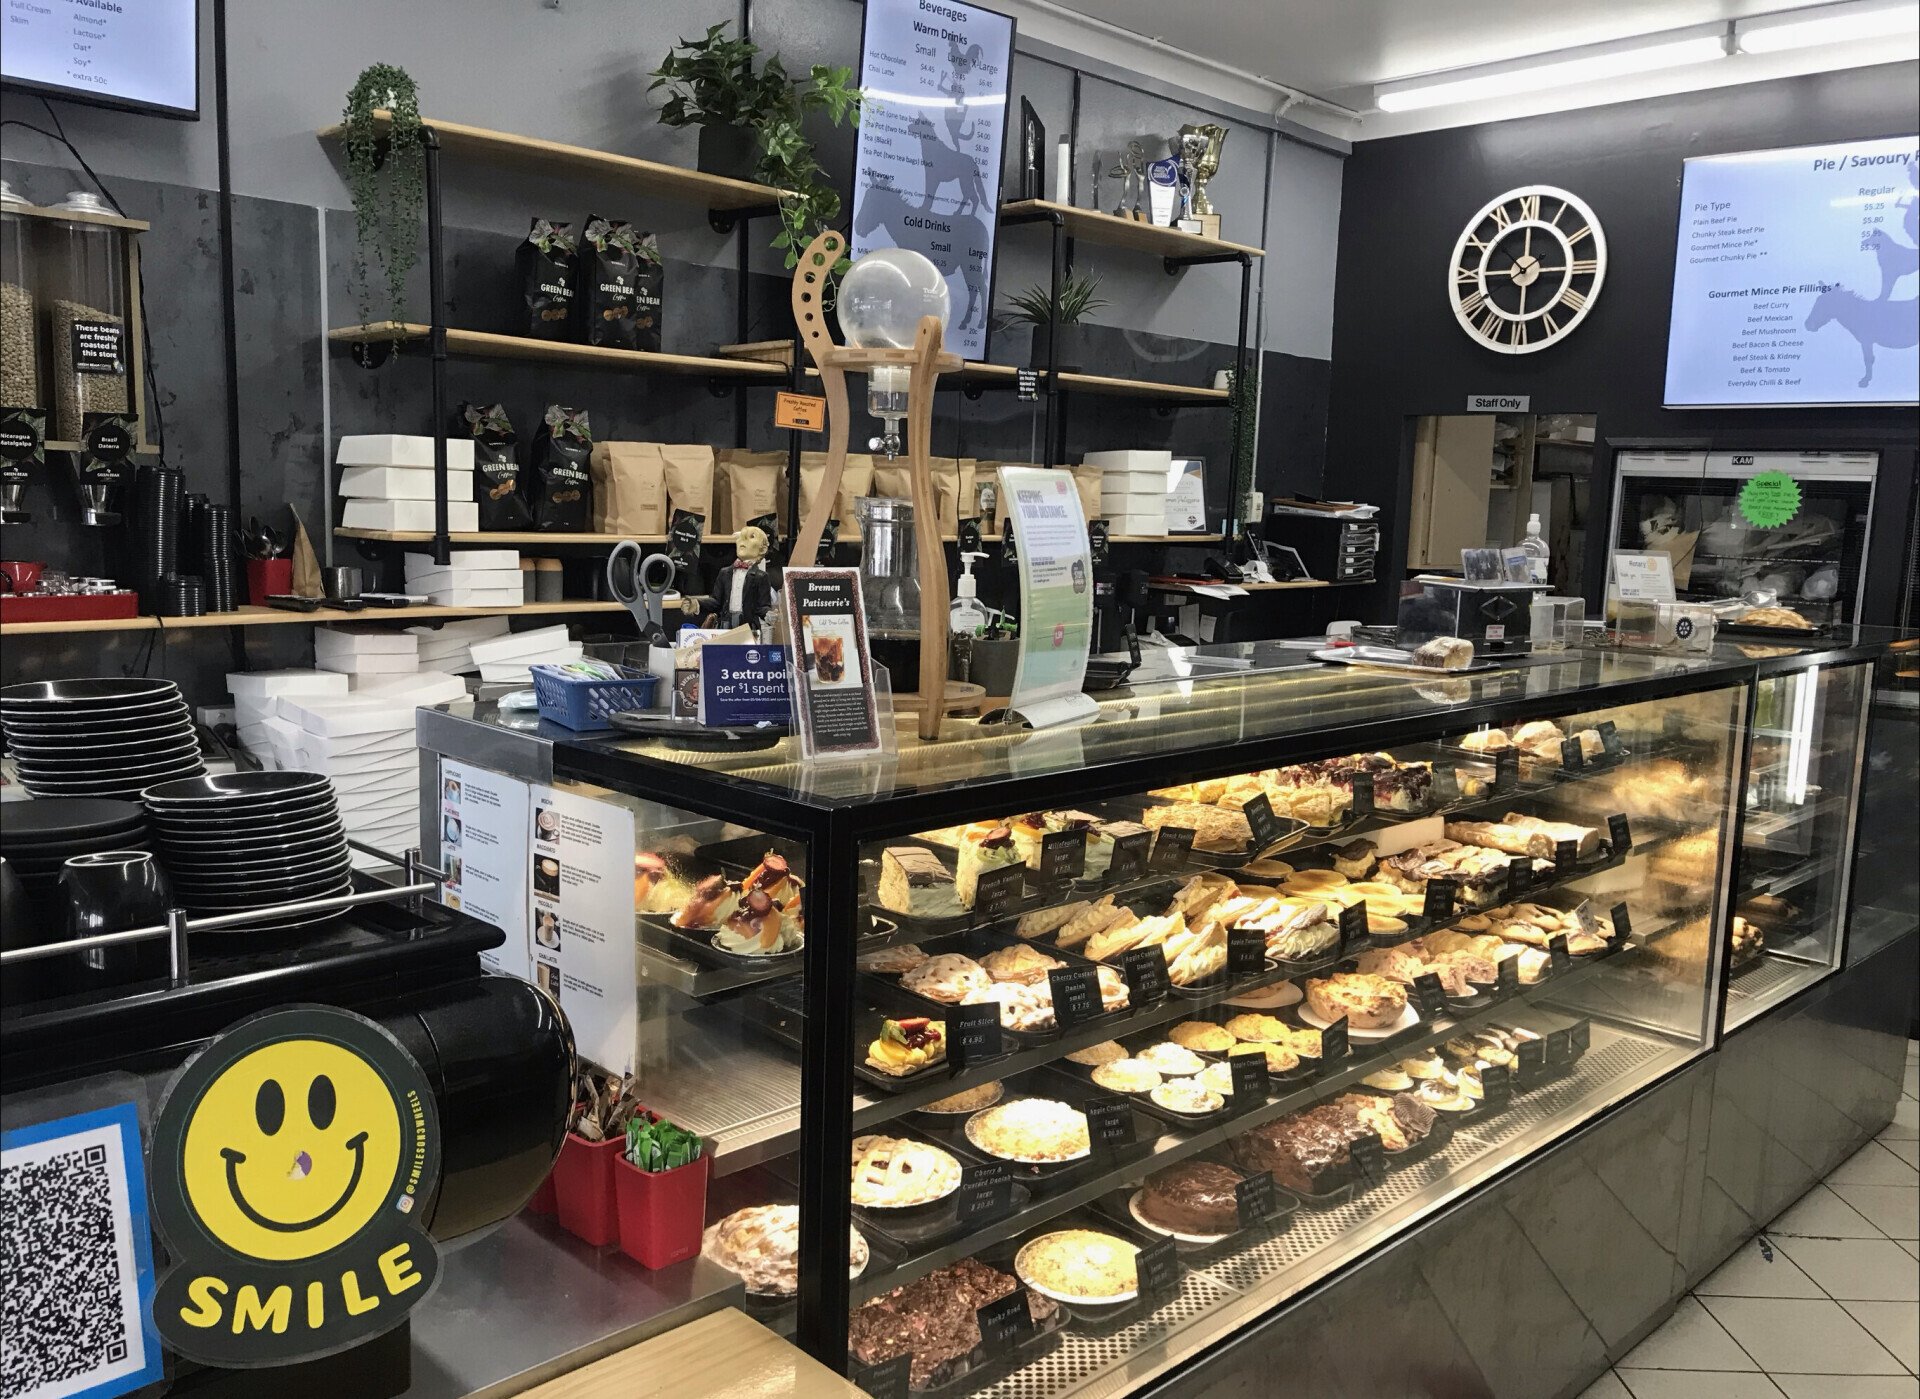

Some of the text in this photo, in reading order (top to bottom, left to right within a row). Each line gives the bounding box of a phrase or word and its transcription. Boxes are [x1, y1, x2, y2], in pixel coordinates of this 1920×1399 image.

[10, 1, 51, 15] Full Cream
[919, 0, 968, 22] Beverages
[10, 15, 29, 25] Skim
[913, 20, 968, 45] Warm Drinks
[869, 50, 907, 66] Hot Chocolate
[915, 43, 999, 75] Small Large X-Large
[868, 64, 895, 78] Chai Latte
[73, 73, 108, 85] extra 50c
[875, 121, 885, 131] Pot
[899, 126, 908, 135] tea
[864, 133, 893, 146] Tea (Black)
[863, 147, 873, 156] Tea
[873, 149, 883, 158] Pot
[883, 151, 896, 162] (two
[897, 154, 906, 162] tea
[906, 155, 920, 167] bags)
[1813, 153, 1911, 171] Pie Savoury
[862, 168, 871, 176] Tea
[1858, 185, 1896, 198] Regular
[1694, 200, 1731, 212] Pie Type
[1863, 202, 1885, 211] $5.25
[904, 215, 951, 233] Cold Drinks
[1693, 215, 1738, 226] Plain Beef Pie
[1691, 226, 1765, 240] Chunky Steak Beef Pie
[930, 240, 988, 260] Small Large
[1691, 243, 1721, 252] Gourmet
[1721, 241, 1741, 250] Mince
[1690, 252, 1758, 264] Gourmet Chunky Pie
[540, 283, 563, 295] GREEN
[600, 283, 622, 294] GREEN
[1708, 283, 1832, 300] Gourmet Mince Pie Fillings
[1753, 302, 1790, 311] Beef Curry
[1747, 314, 1794, 323] Beef Mexican
[75, 324, 120, 335] These beans
[1741, 327, 1797, 336] Beef Mushroom
[94, 334, 118, 344] freshly
[1732, 341, 1748, 349] Beef
[1749, 340, 1771, 349] Bacon
[1778, 340, 1805, 348] Cheese
[80, 342, 111, 350] roasted
[98, 351, 117, 359] store
[1733, 352, 1801, 362] Beef Steak & Kidney
[1740, 365, 1791, 374] Beef & Tomato
[1728, 377, 1802, 388] Everyday Chilli & Beef
[1475, 398, 1521, 409] Staff Only
[0, 433, 31, 441] Nicaragua
[1732, 456, 1754, 465] KAM
[482, 463, 506, 473] GREEN
[553, 467, 575, 478] GREEN
[808, 582, 841, 592] Bremen
[802, 598, 850, 607] Patisserie's
[721, 669, 786, 682] 3 extra poi
[716, 682, 785, 696] per $1 spent
[1051, 969, 1098, 983] Cherry Custard
[1065, 982, 1086, 993] Danish
[1069, 993, 1086, 1001] small
[960, 1017, 995, 1028] Fruit Slice
[1106, 1103, 1130, 1112] Crumble
[974, 1168, 996, 1178] Cherry
[962, 1174, 1012, 1191] Custard Danish
[180, 1242, 423, 1335] SMILE
[1006, 1304, 1021, 1316] Road
